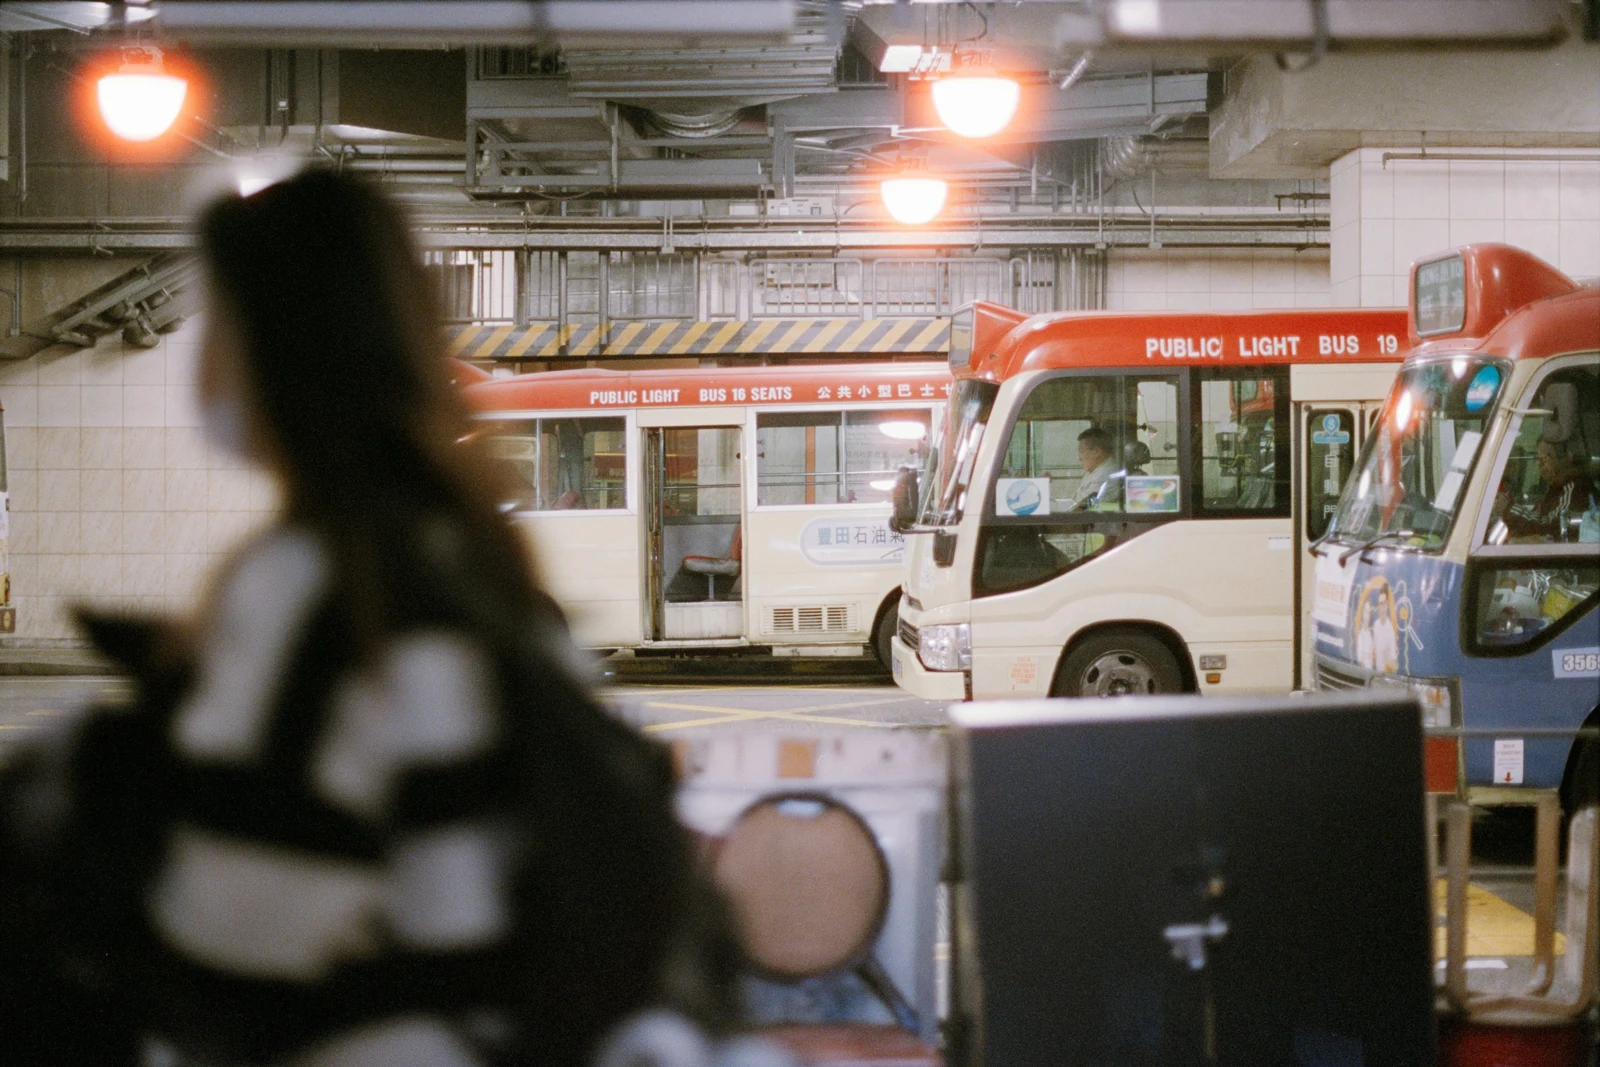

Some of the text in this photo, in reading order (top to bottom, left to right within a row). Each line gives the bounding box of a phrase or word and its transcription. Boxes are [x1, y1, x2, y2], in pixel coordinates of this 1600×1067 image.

[1145, 333, 1399, 360] PUBLIC LIGHT BUS 19
[589, 386, 793, 405] PUBLIC LIGHT BUS 16 SEATS
[1562, 653, 1600, 672] 356
